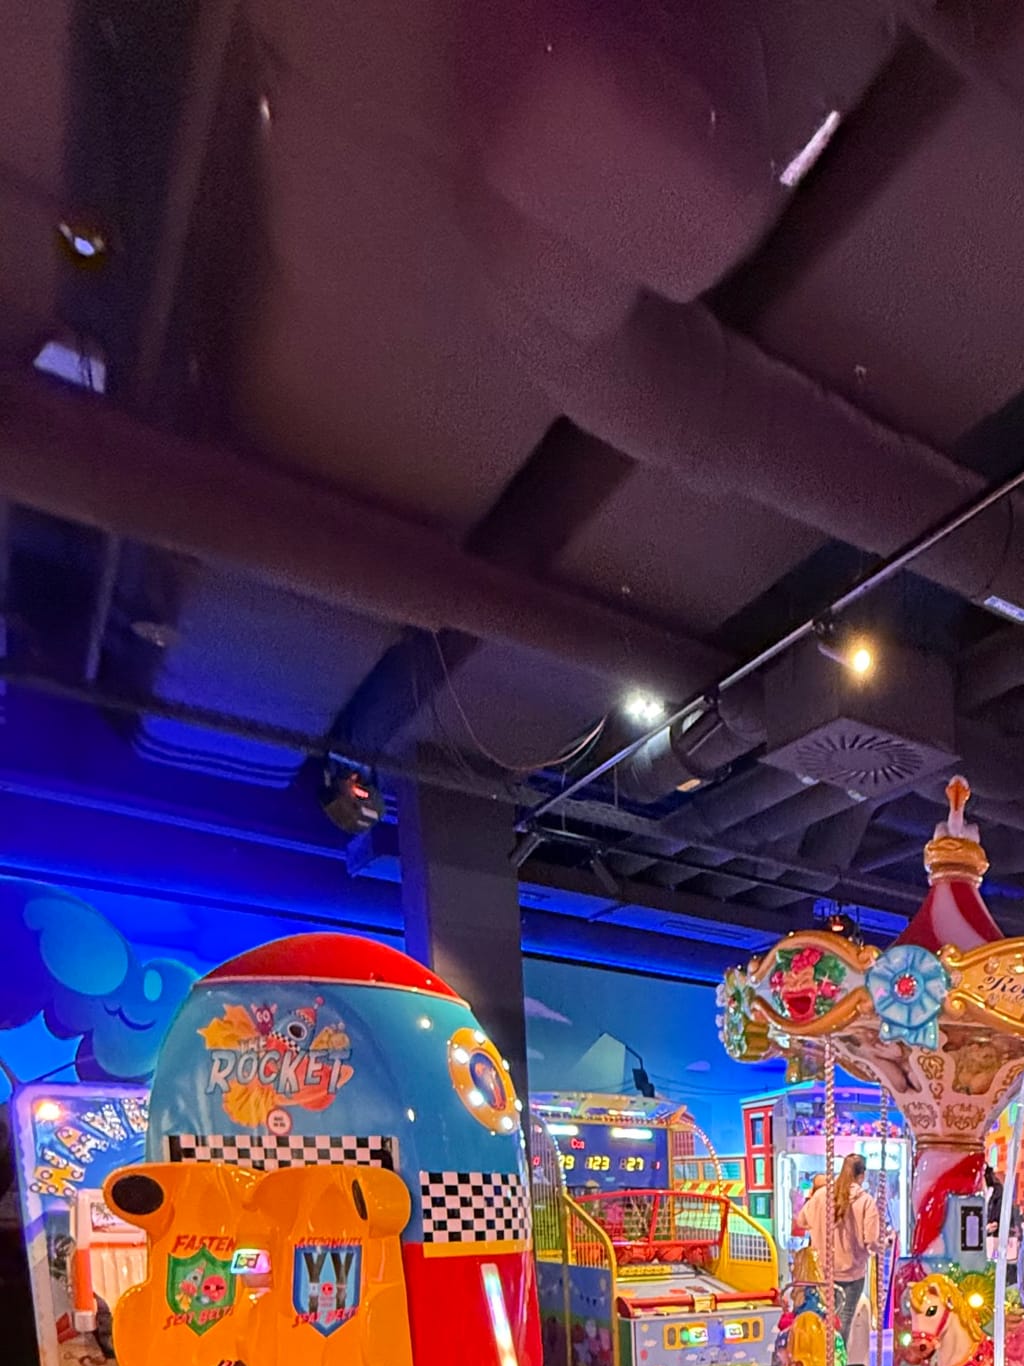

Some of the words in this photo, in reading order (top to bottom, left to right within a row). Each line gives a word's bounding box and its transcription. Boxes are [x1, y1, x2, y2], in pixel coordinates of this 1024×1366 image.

[206, 1049, 352, 1096] ROCKET
[171, 1234, 236, 1254] FASTEN
[163, 1310, 195, 1330] SEAT
